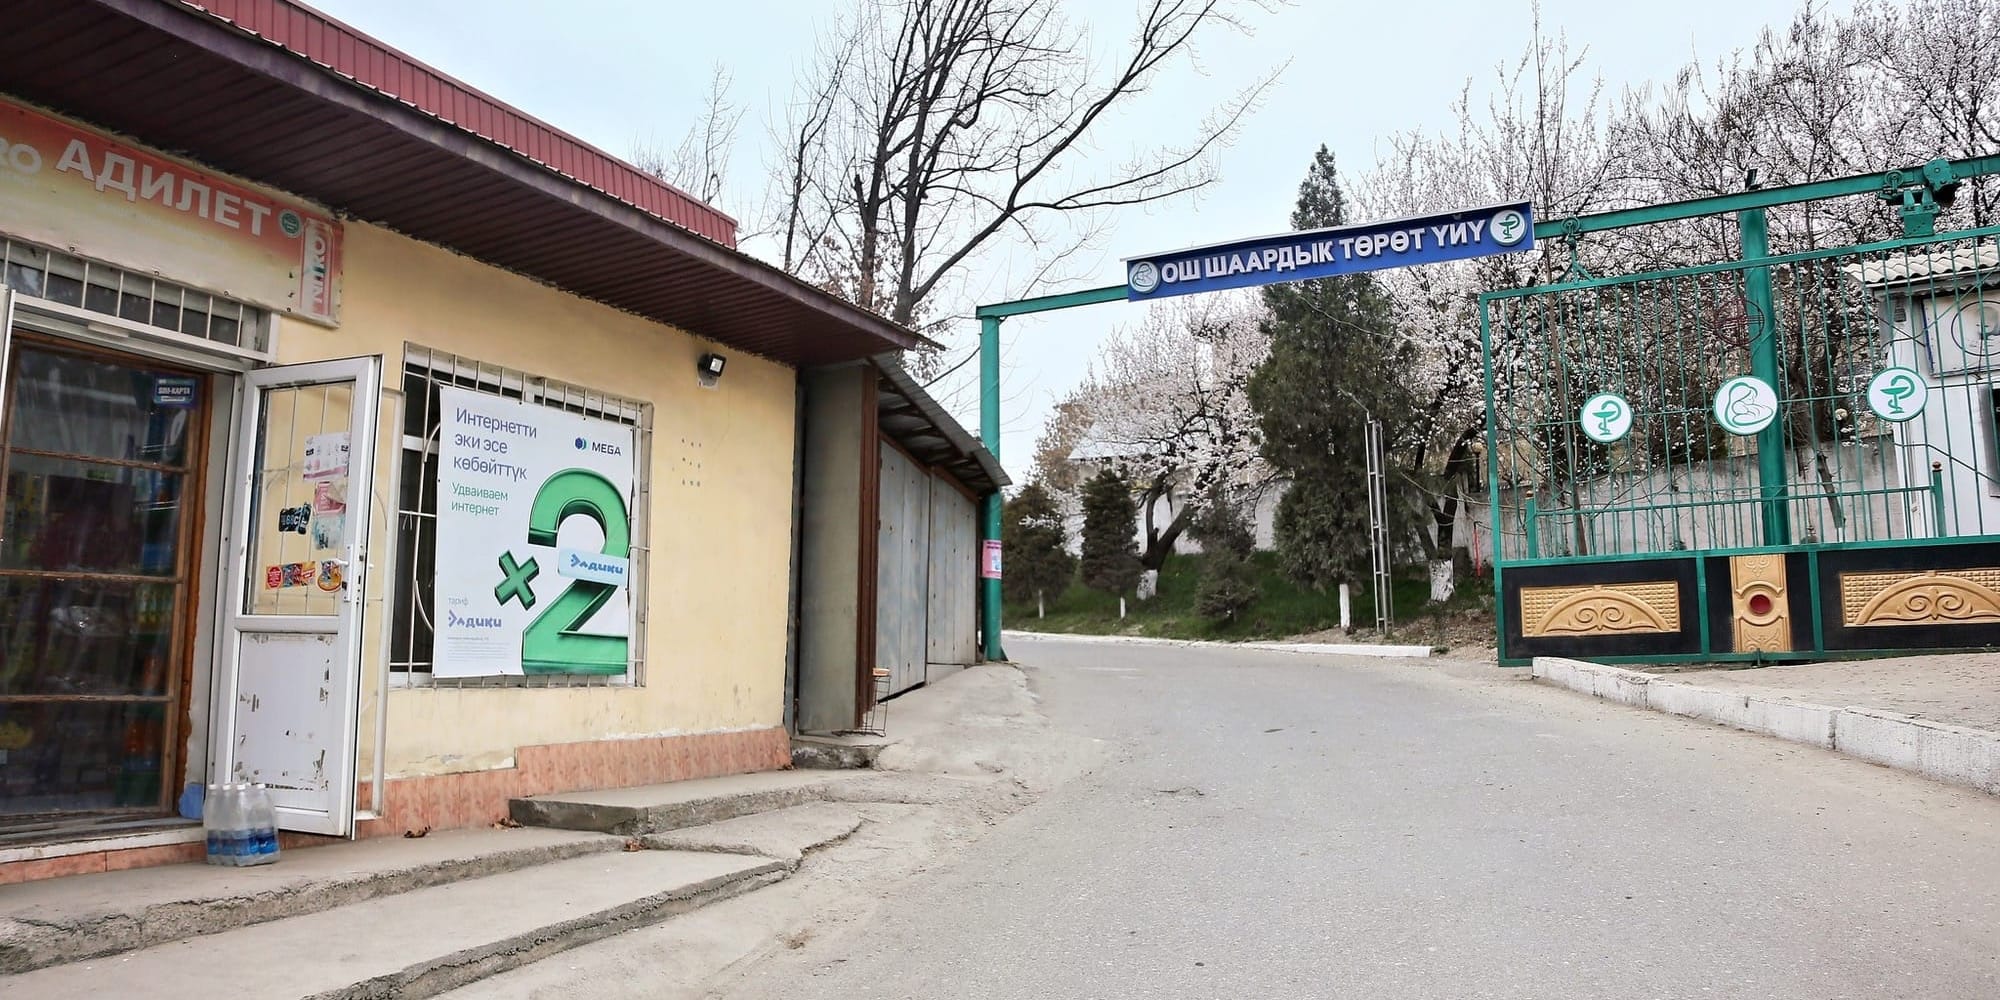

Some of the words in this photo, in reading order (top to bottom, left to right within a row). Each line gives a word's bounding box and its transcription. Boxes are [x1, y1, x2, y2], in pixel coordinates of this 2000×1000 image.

[55, 138, 271, 236] АДИЛЕТ
[1160, 260, 1201, 284] ОШ
[1204, 240, 1335, 279] ШААРДЫК
[1339, 227, 1426, 262] ТӨРӨТ
[455, 407, 537, 438] Интернетти
[454, 433, 480, 450] эки
[483, 436, 508, 454] эсе
[591, 441, 622, 456] MEGA
[453, 456, 528, 482] көбөйттүк
[451, 481, 508, 501] Удваиваем
[451, 501, 500, 516] интернет
